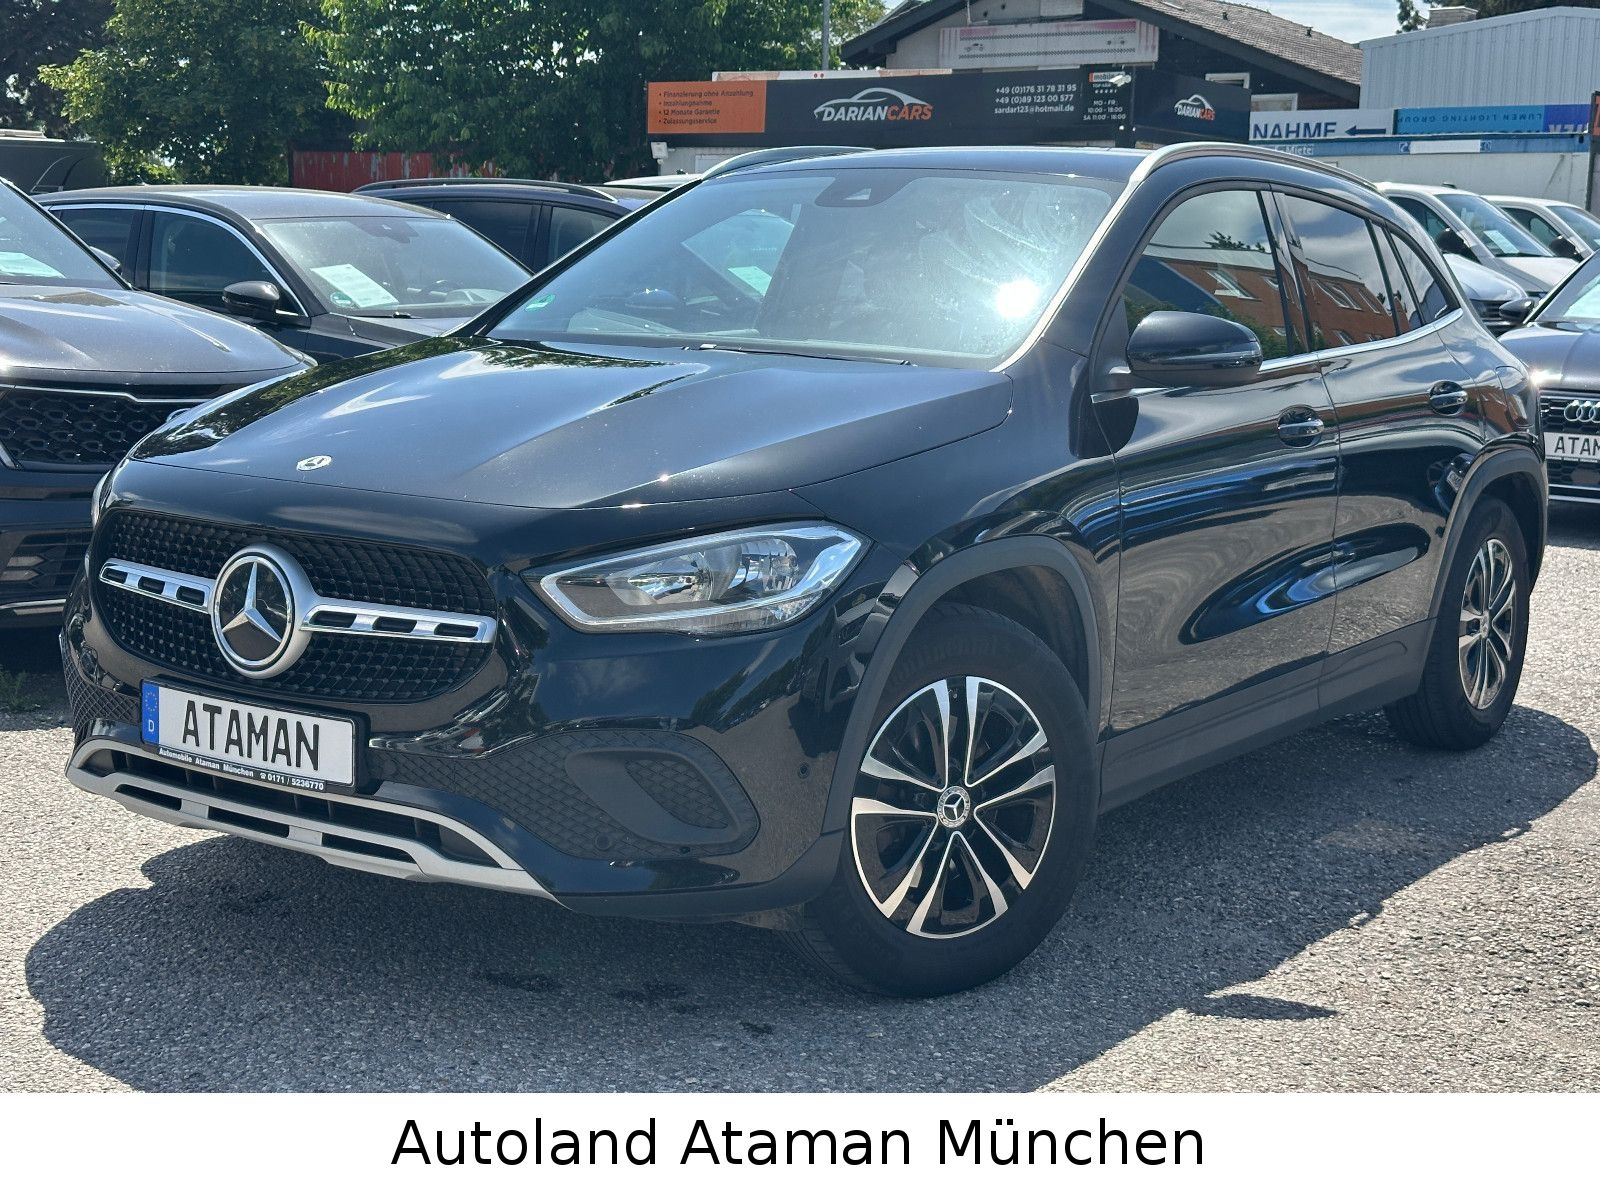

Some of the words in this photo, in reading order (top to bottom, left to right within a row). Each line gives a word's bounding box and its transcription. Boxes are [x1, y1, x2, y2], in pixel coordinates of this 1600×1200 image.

[1036, 85, 1045, 93] 31
[1057, 84, 1065, 92] 31
[1066, 84, 1077, 92] 95
[1033, 95, 1046, 103] 123
[1047, 94, 1058, 102] 00
[1060, 94, 1074, 102] 577
[822, 104, 933, 121] DARIANCARS
[1503, 112, 1542, 121] LUMEN
[148, 719, 155, 733] D
[182, 700, 320, 771] ATAMAN
[159, 748, 193, 763] Automobile
[195, 757, 220, 770] Ataman
[223, 763, 254, 778] München
[268, 773, 285, 784] 0171
[291, 777, 324, 791] 5236770
